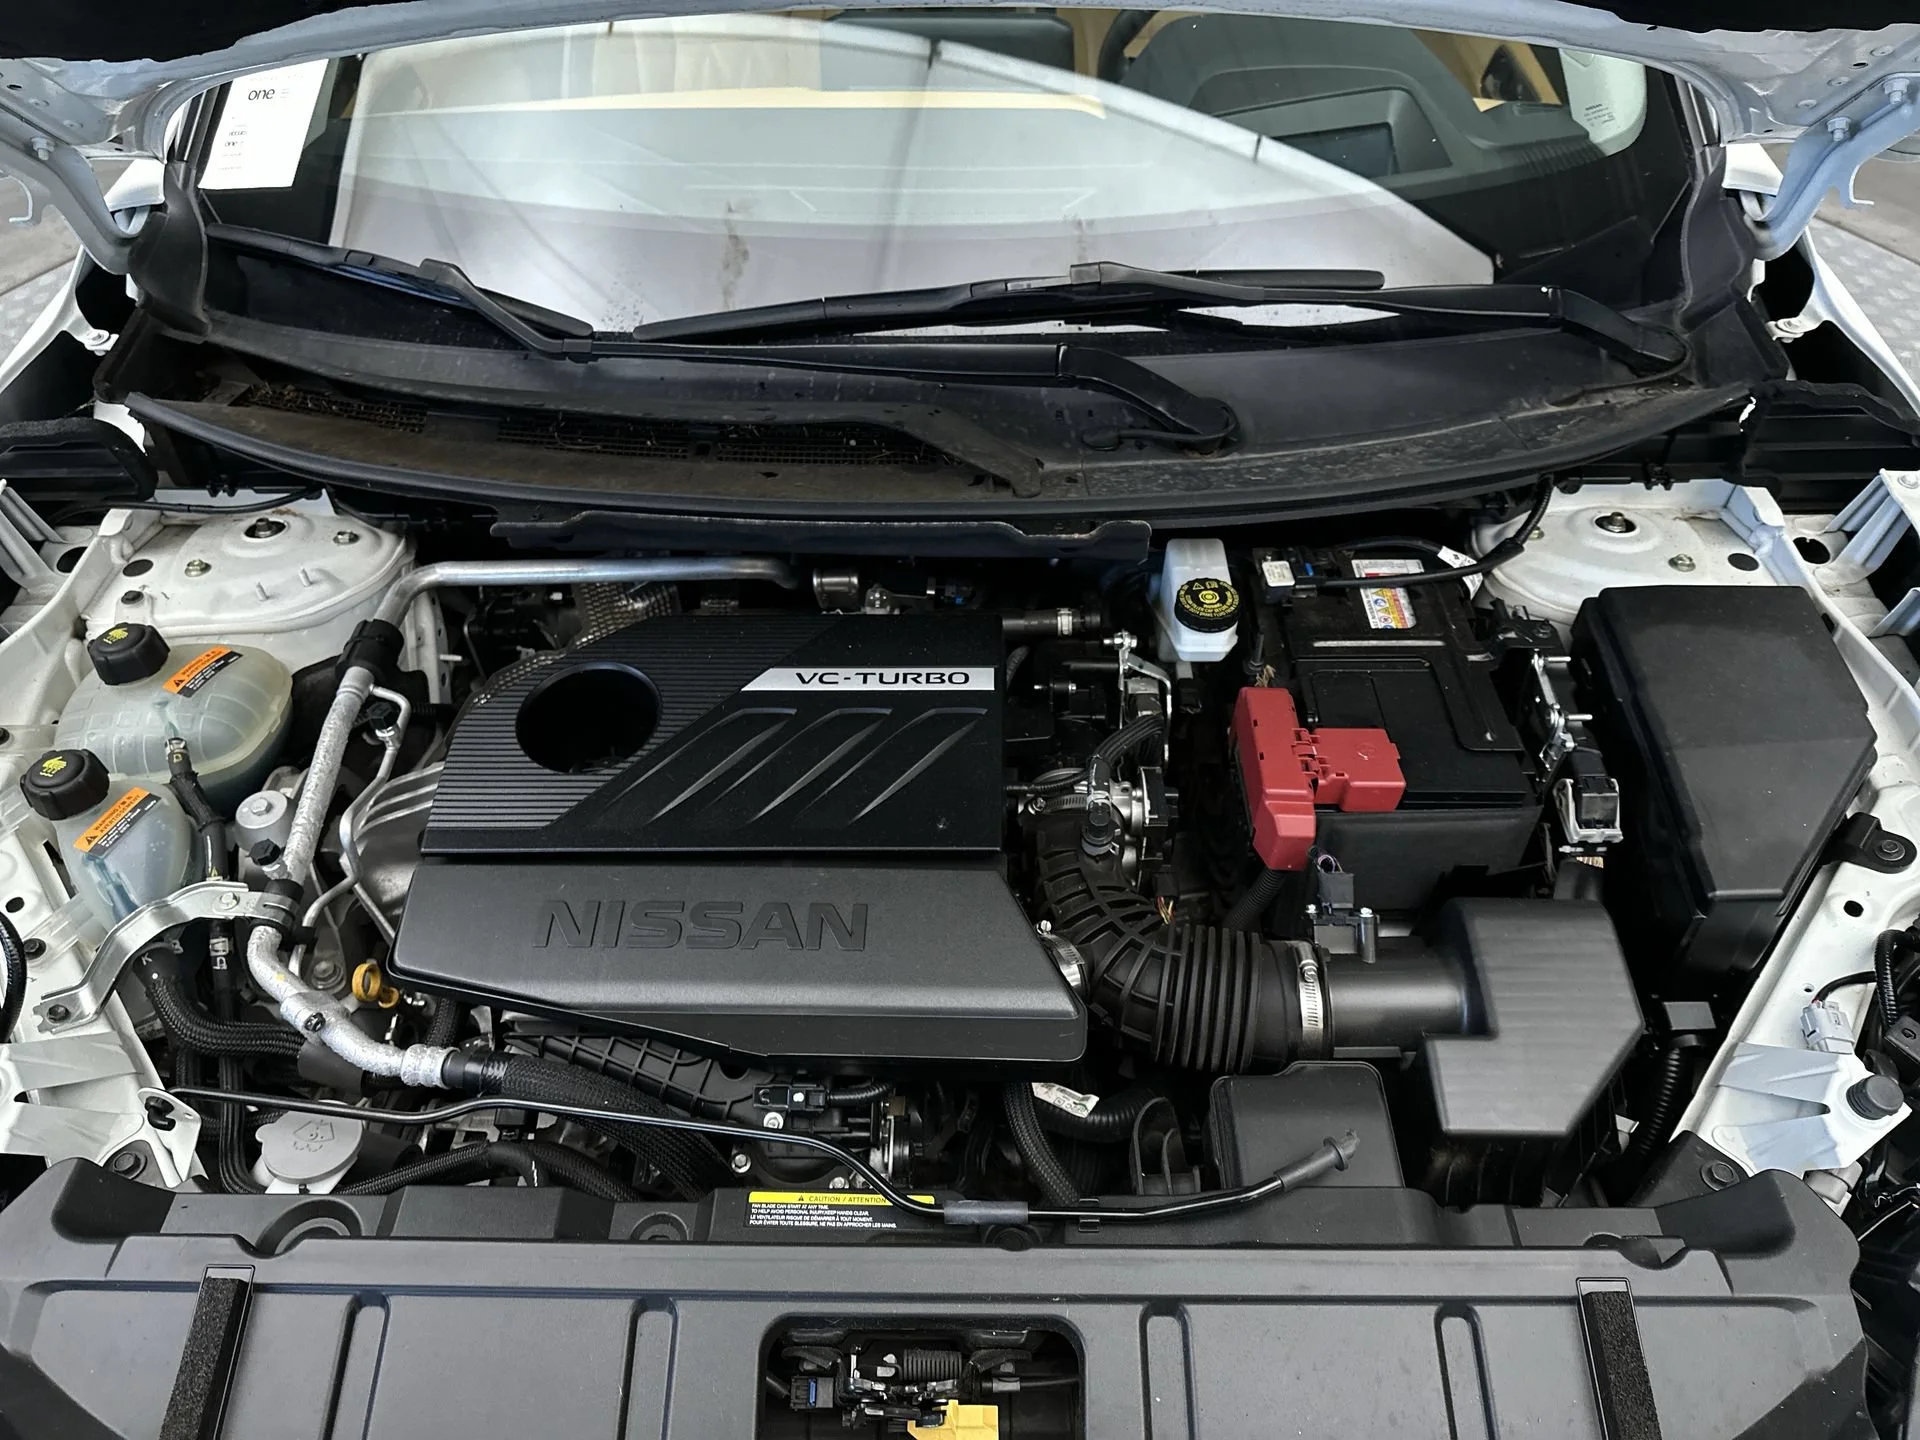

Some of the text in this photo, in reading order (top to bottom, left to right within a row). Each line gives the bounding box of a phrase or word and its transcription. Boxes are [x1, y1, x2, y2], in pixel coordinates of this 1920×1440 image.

[247, 88, 276, 101] one
[796, 672, 970, 685] VC-TURBO
[533, 900, 869, 951] NISSAN
[808, 1195, 841, 1203] CAUTION
[847, 1196, 887, 1204] ATTENTION
